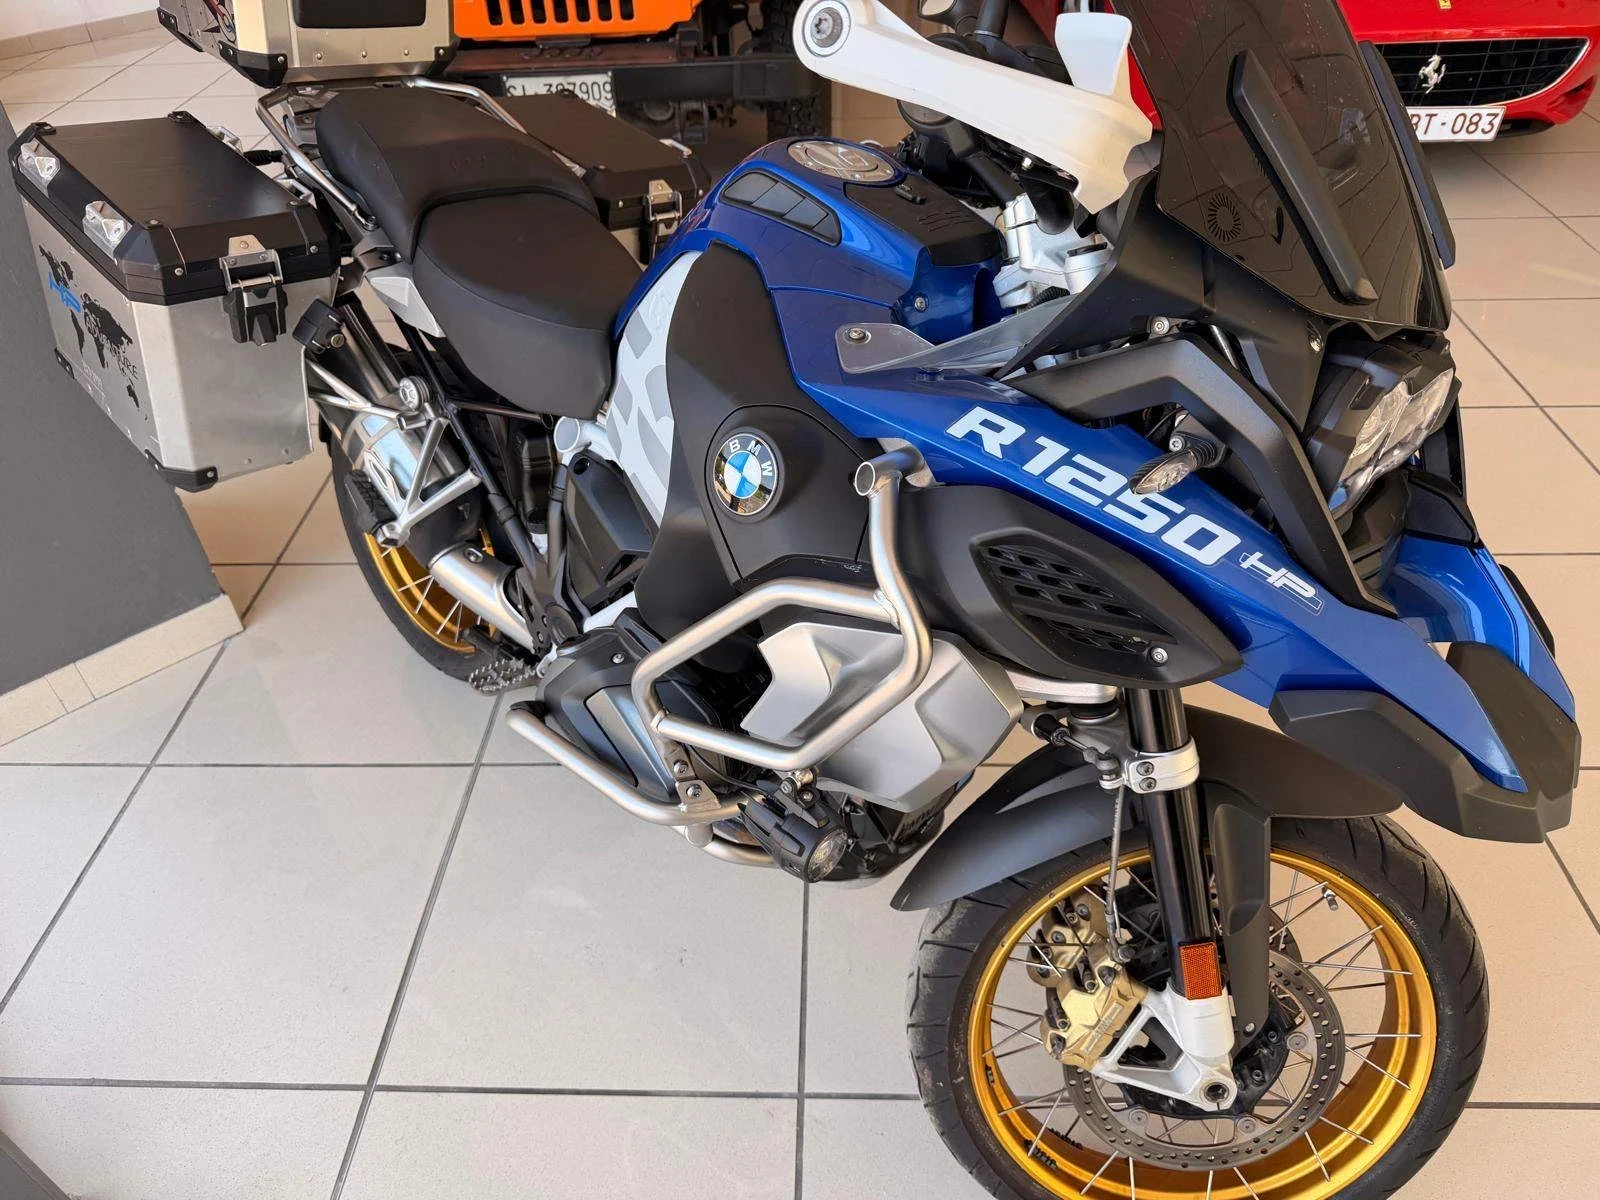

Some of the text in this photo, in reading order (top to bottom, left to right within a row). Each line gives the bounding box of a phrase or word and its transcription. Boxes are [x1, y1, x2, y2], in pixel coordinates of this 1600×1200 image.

[729, 439, 773, 477] BMW
[945, 406, 1319, 602] R 1250 HP
